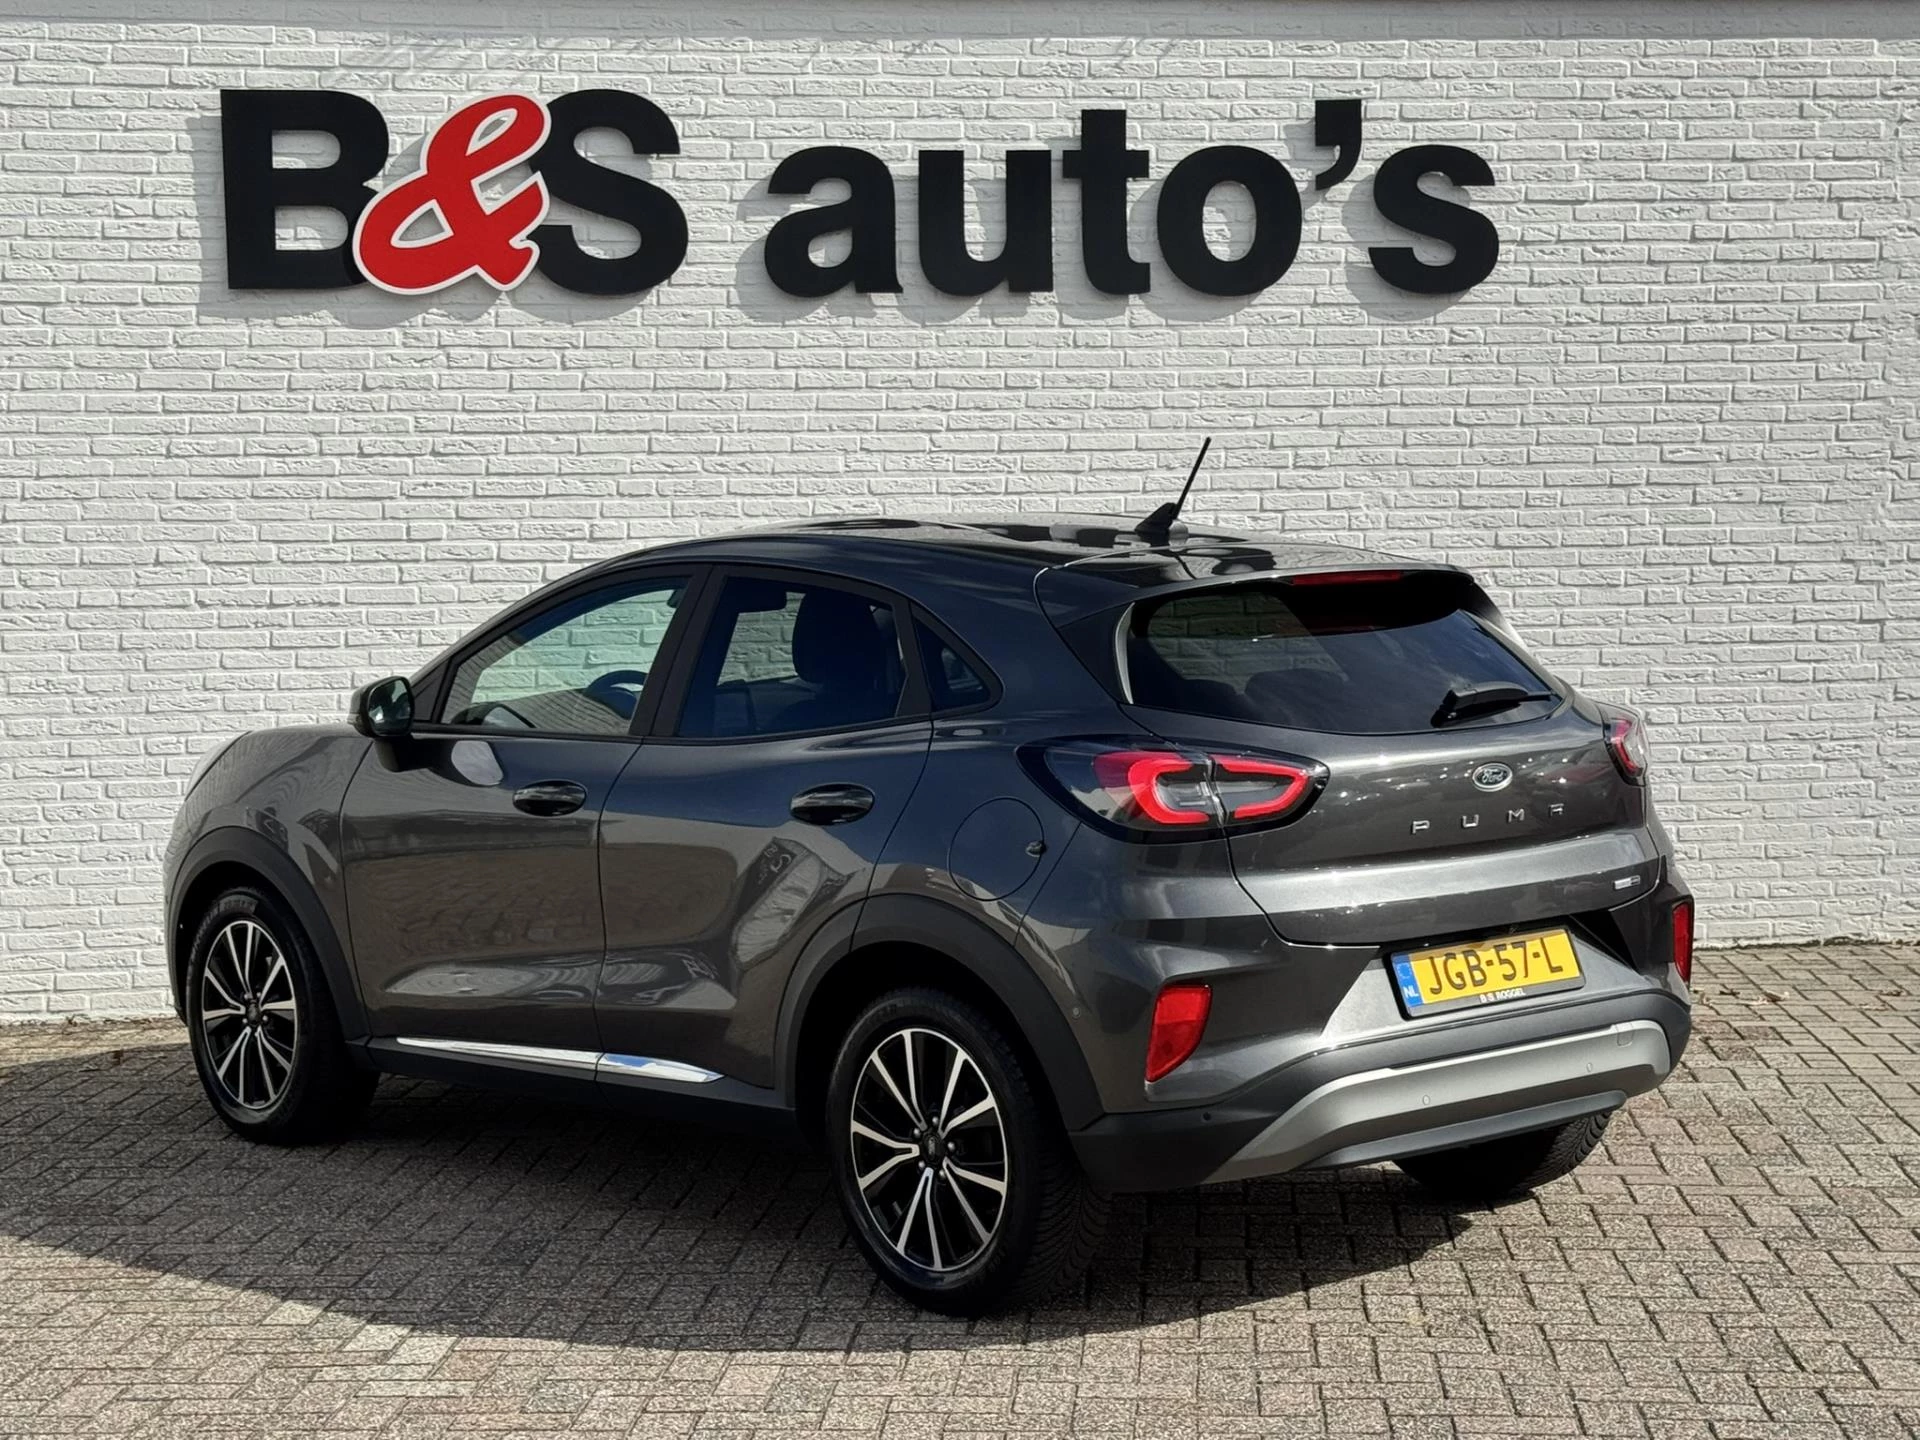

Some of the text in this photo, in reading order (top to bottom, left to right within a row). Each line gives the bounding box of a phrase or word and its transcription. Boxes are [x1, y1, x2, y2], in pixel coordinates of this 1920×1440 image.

[220, 88, 1500, 298] B&S auto's
[1412, 803, 1565, 834] PUMA
[1429, 937, 1564, 995] JGB-57-L
[1403, 985, 1419, 998] NL
